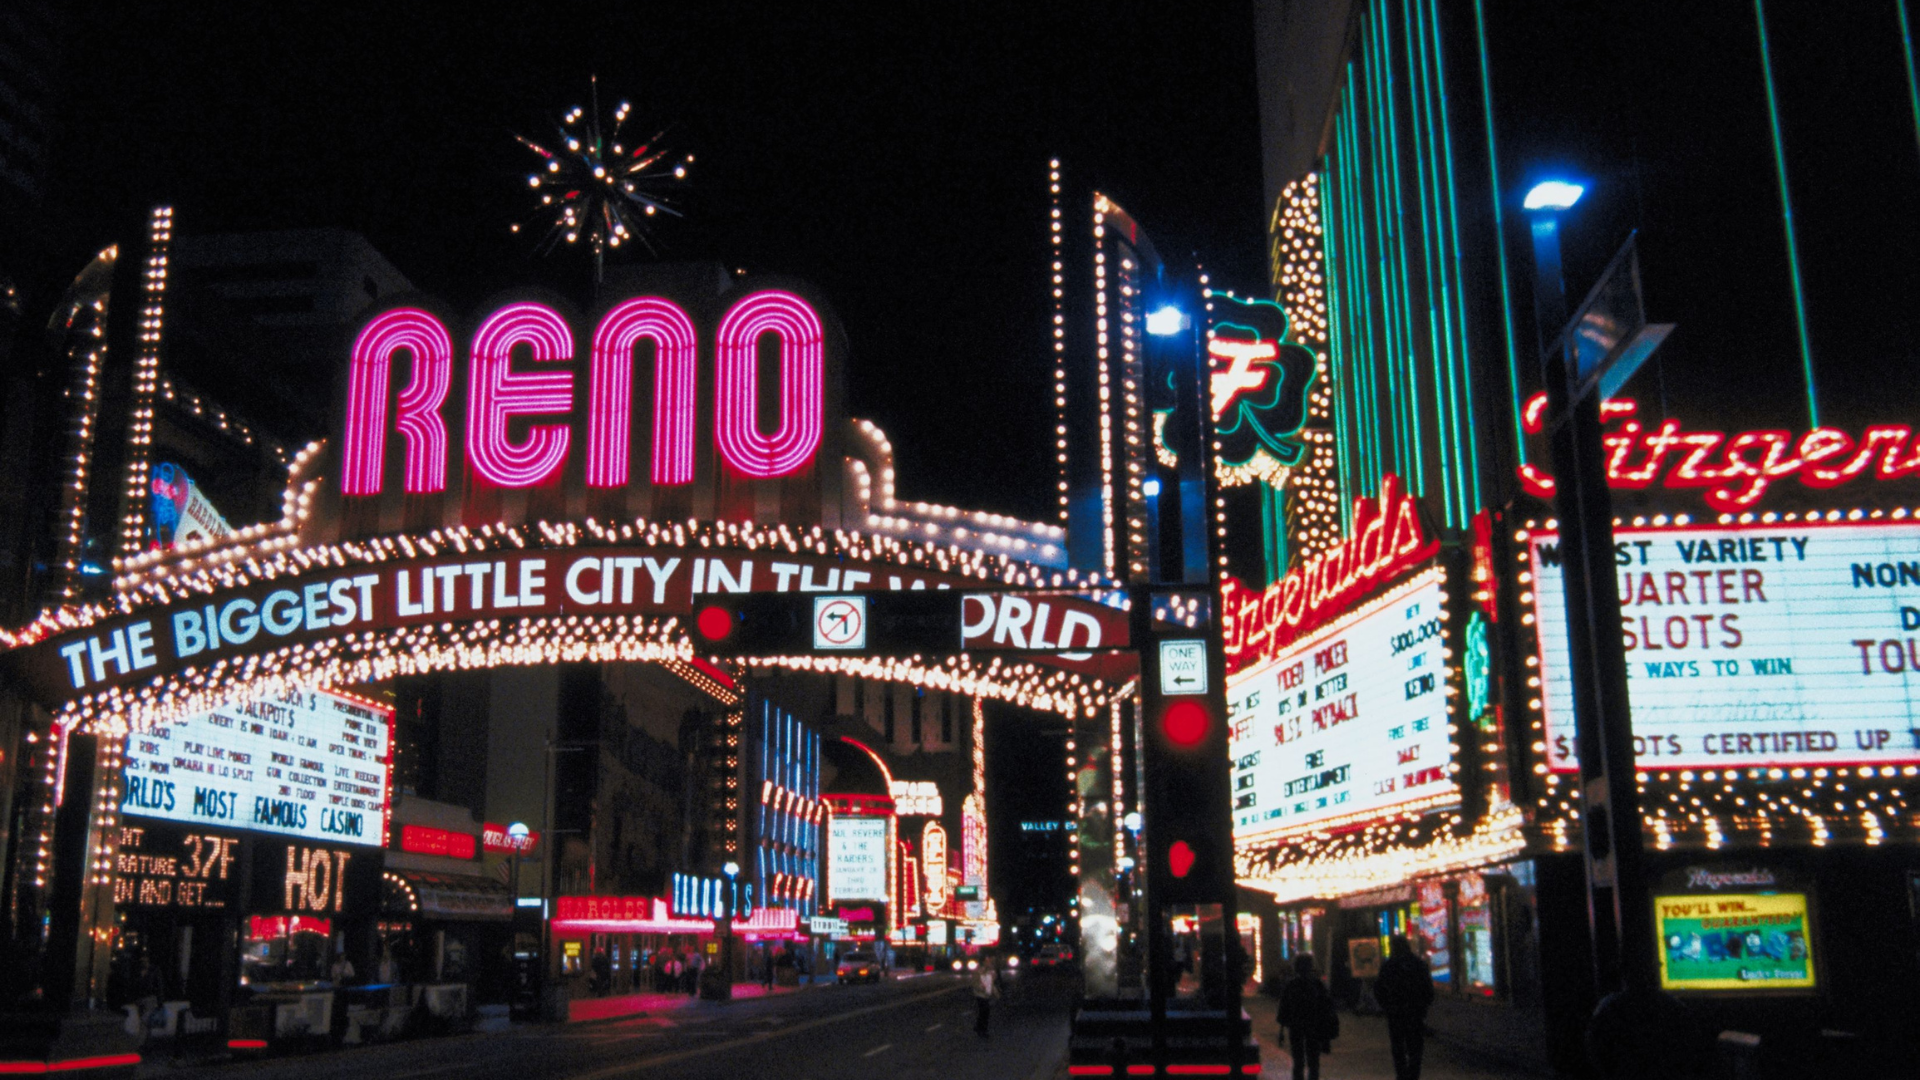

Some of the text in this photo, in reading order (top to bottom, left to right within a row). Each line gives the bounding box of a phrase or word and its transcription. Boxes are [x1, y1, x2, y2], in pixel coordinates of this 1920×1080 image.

[341, 288, 824, 496] RENO
[1536, 536, 1808, 569] WST VARIETY
[1617, 569, 1768, 607] UARTER
[1850, 560, 1920, 589] NON
[61, 621, 157, 689] THE
[173, 573, 379, 659] BIGGEST
[397, 559, 546, 616] LITTLE
[565, 556, 681, 605] CITY
[692, 558, 753, 594] IN
[889, 576, 1102, 661] ORLD
[1621, 613, 1743, 652] SLOTS
[1168, 647, 1196, 659] ONE
[1169, 661, 1197, 671] WAY
[1314, 639, 1349, 678] POKER
[1645, 660, 1700, 679] WAYS
[1712, 659, 1739, 677] TO
[1750, 657, 1793, 676] WIN
[1405, 672, 1435, 701] KENO
[1312, 692, 1359, 734] PAYBACK
[183, 741, 204, 755] PLAY
[1632, 733, 1683, 756] OTS
[1703, 730, 1838, 755] CERTIFIED
[1855, 729, 1891, 751] UP
[193, 786, 238, 820] MOST
[254, 796, 307, 830] FAMOUS
[320, 807, 363, 837] CASINO
[1021, 821, 1059, 831] VALLEY
[484, 830, 511, 848] OUGLAS
[118, 854, 177, 876] RATURE
[182, 834, 239, 879] 37F
[139, 879, 172, 905] AND
[285, 845, 351, 912] HOT
[1662, 902, 1710, 917] YOU'LL
